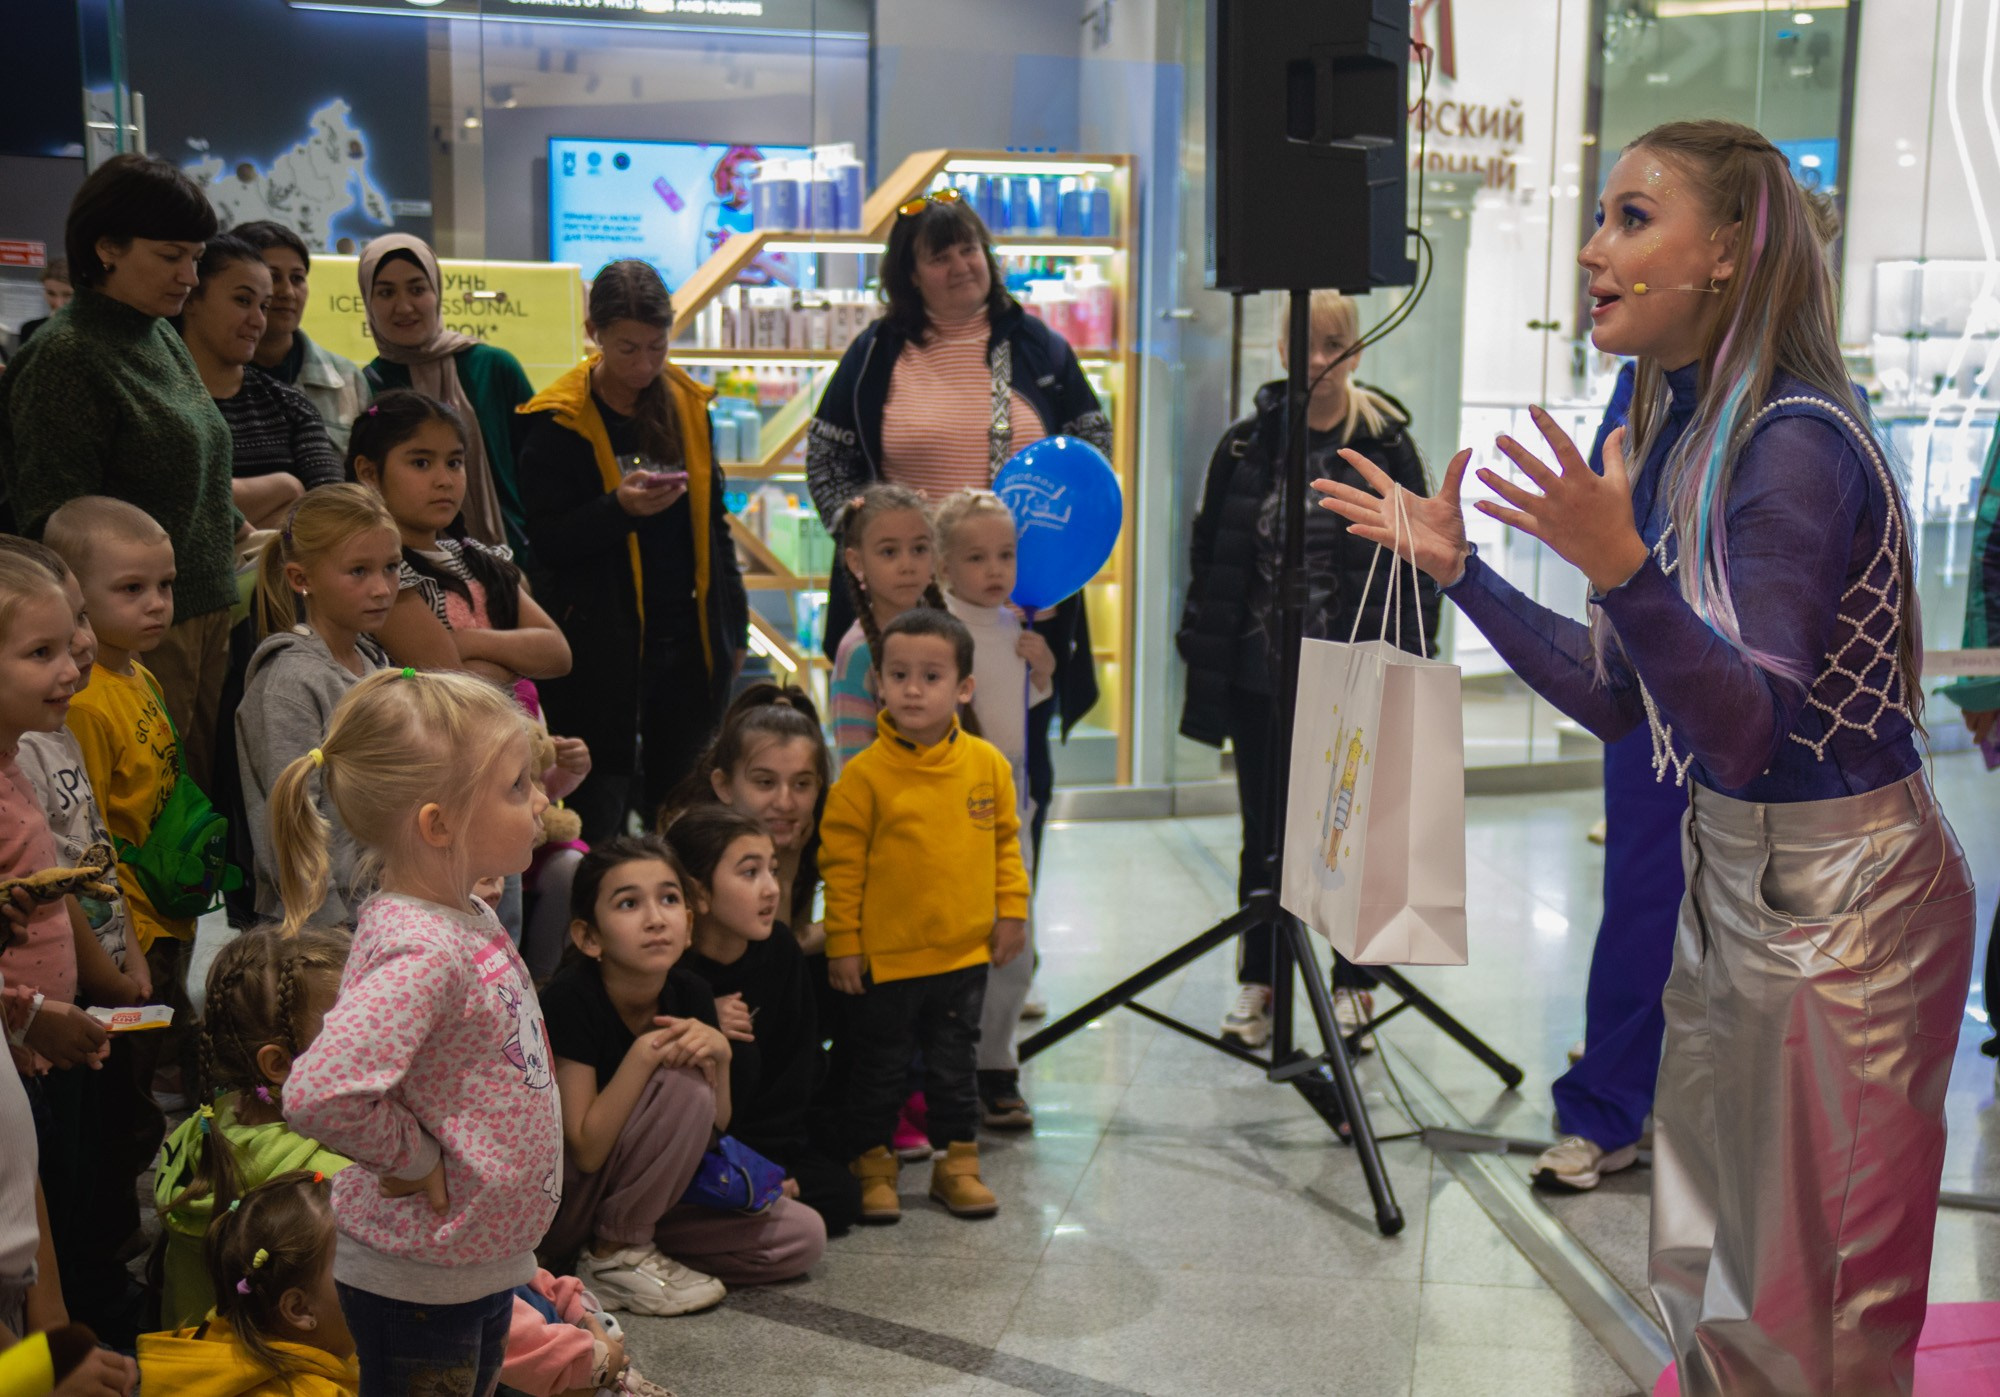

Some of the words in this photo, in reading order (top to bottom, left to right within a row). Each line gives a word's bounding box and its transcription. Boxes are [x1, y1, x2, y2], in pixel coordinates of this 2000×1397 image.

[1414, 98, 1525, 144] ВСКИЙ
[444, 273, 487, 291] УНЬ
[441, 297, 529, 318] SSIONAL
